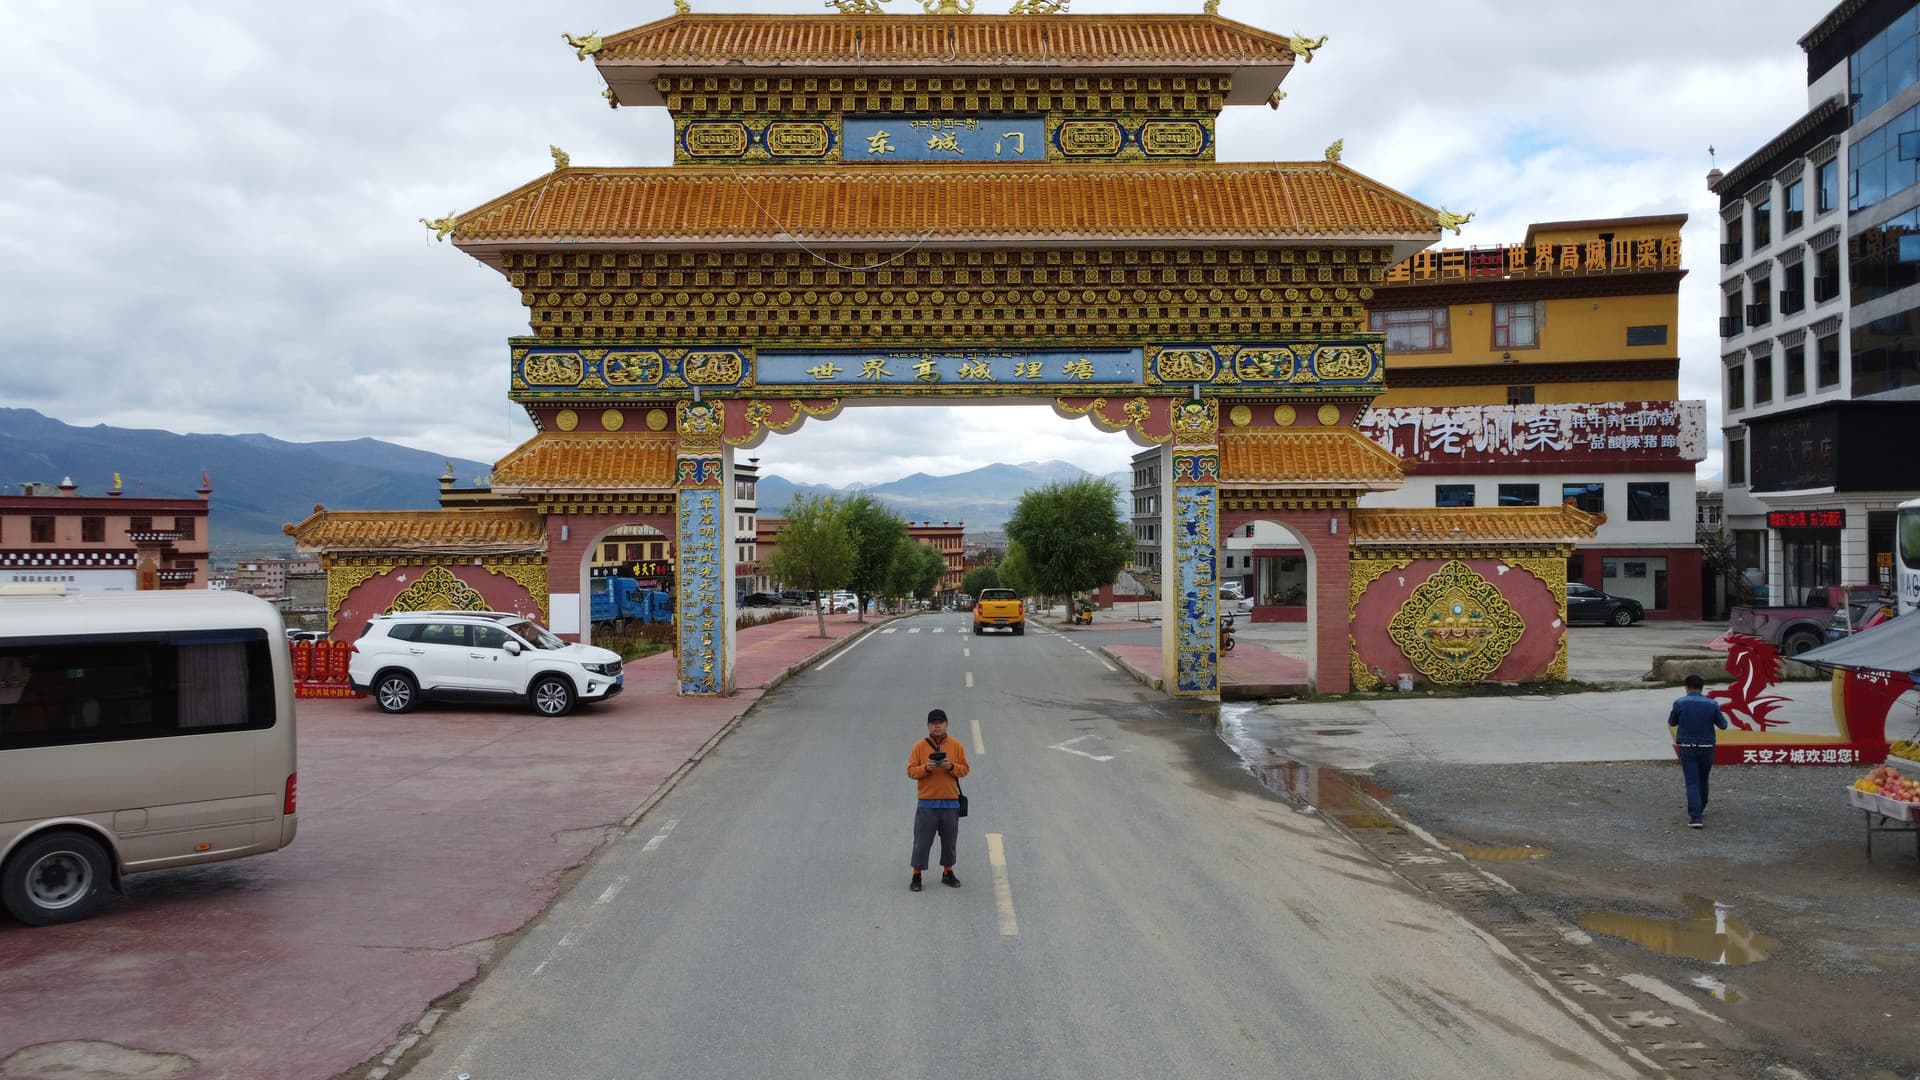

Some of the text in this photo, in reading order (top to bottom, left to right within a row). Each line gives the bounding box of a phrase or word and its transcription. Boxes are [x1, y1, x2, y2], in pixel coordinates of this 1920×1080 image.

[866, 130, 1025, 156] 东城门
[1508, 236, 1681, 273] 世界高城川菜馆
[806, 358, 1095, 384] 世界高城理塘
[1572, 434, 1677, 449] 一品酸辣猪蹄
